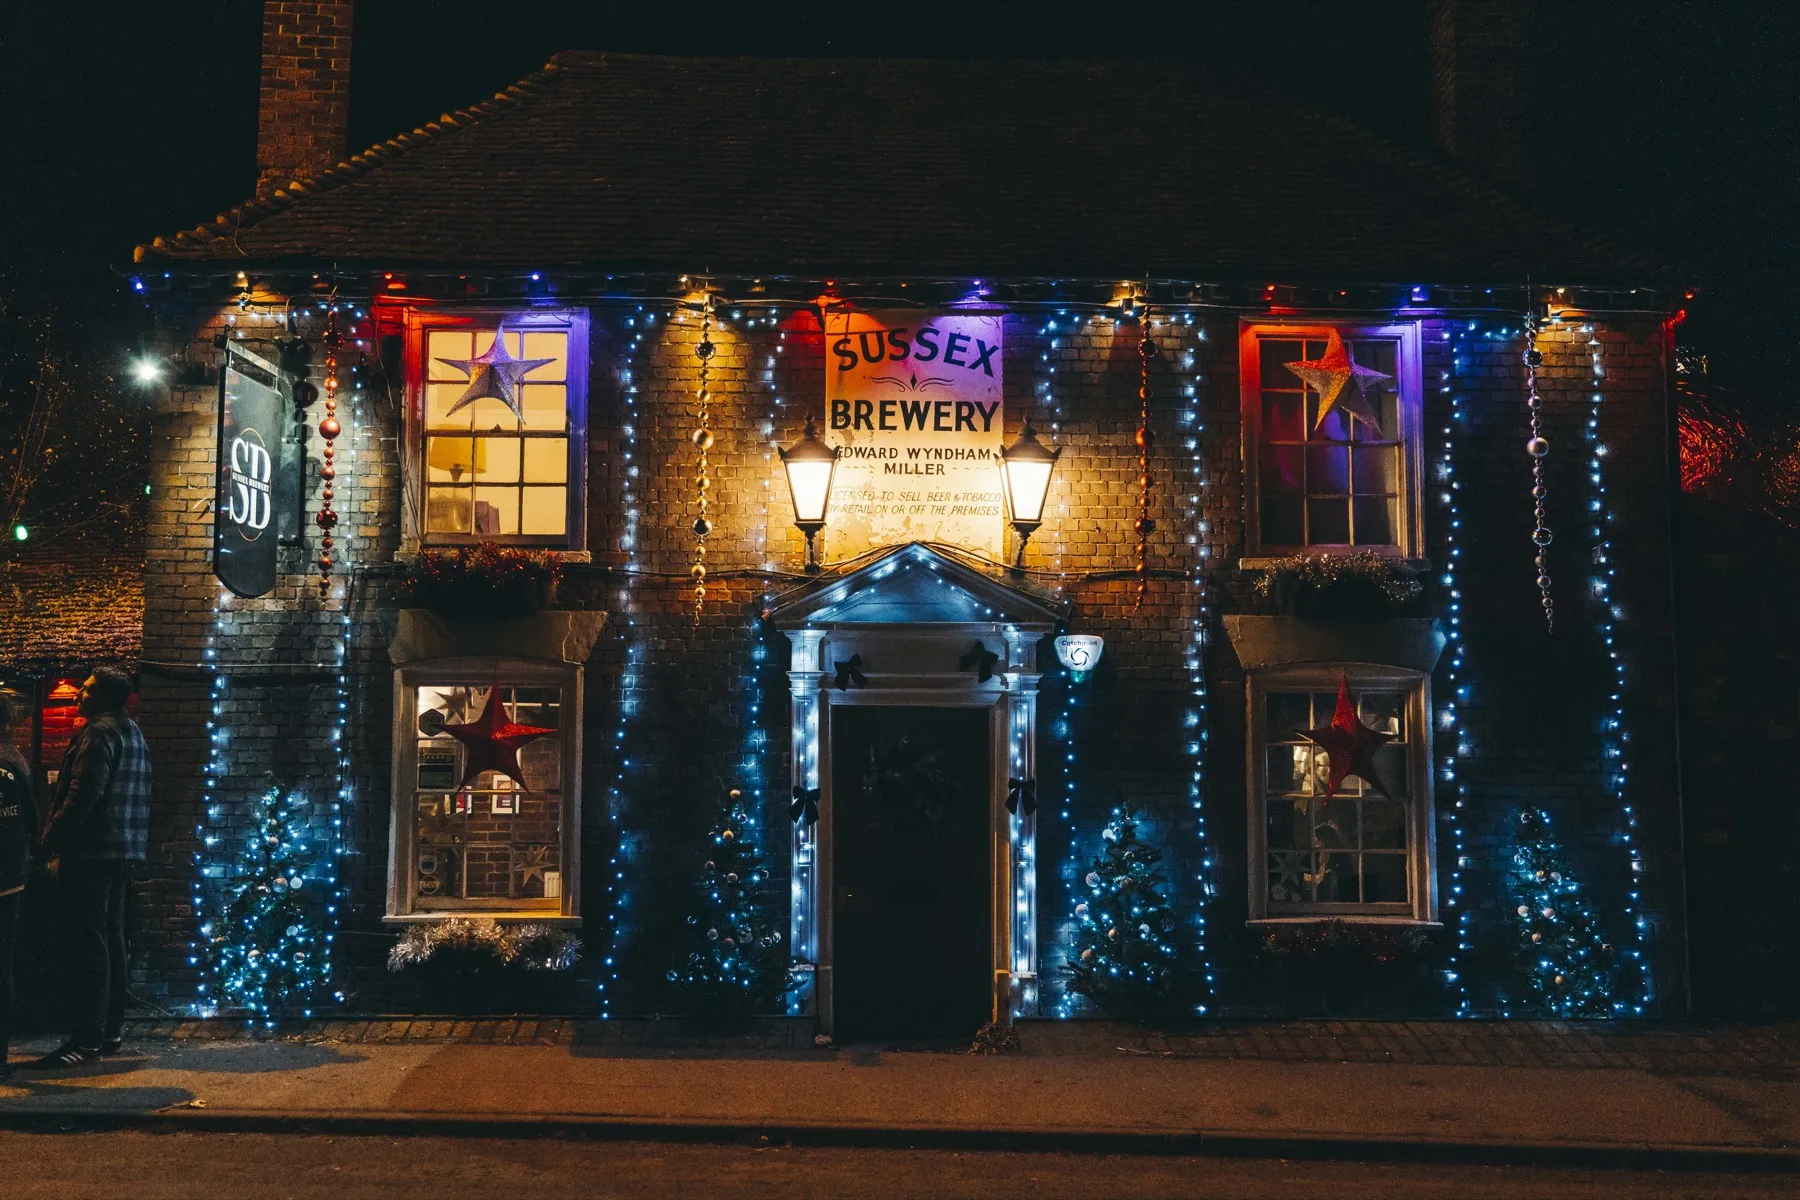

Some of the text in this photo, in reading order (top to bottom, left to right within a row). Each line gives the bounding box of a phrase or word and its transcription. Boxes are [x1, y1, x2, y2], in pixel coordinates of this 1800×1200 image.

[832, 327, 999, 377] SUSSEX
[831, 399, 1000, 432] BREWERY
[907, 447, 990, 461] WYNDHAM
[884, 462, 946, 476] MILLER
[829, 490, 1001, 503] LICENSED TO SELL BEER & TOBACCO
[827, 504, 1000, 516] BY RETAIL ON OR OFF THE PREMISES
